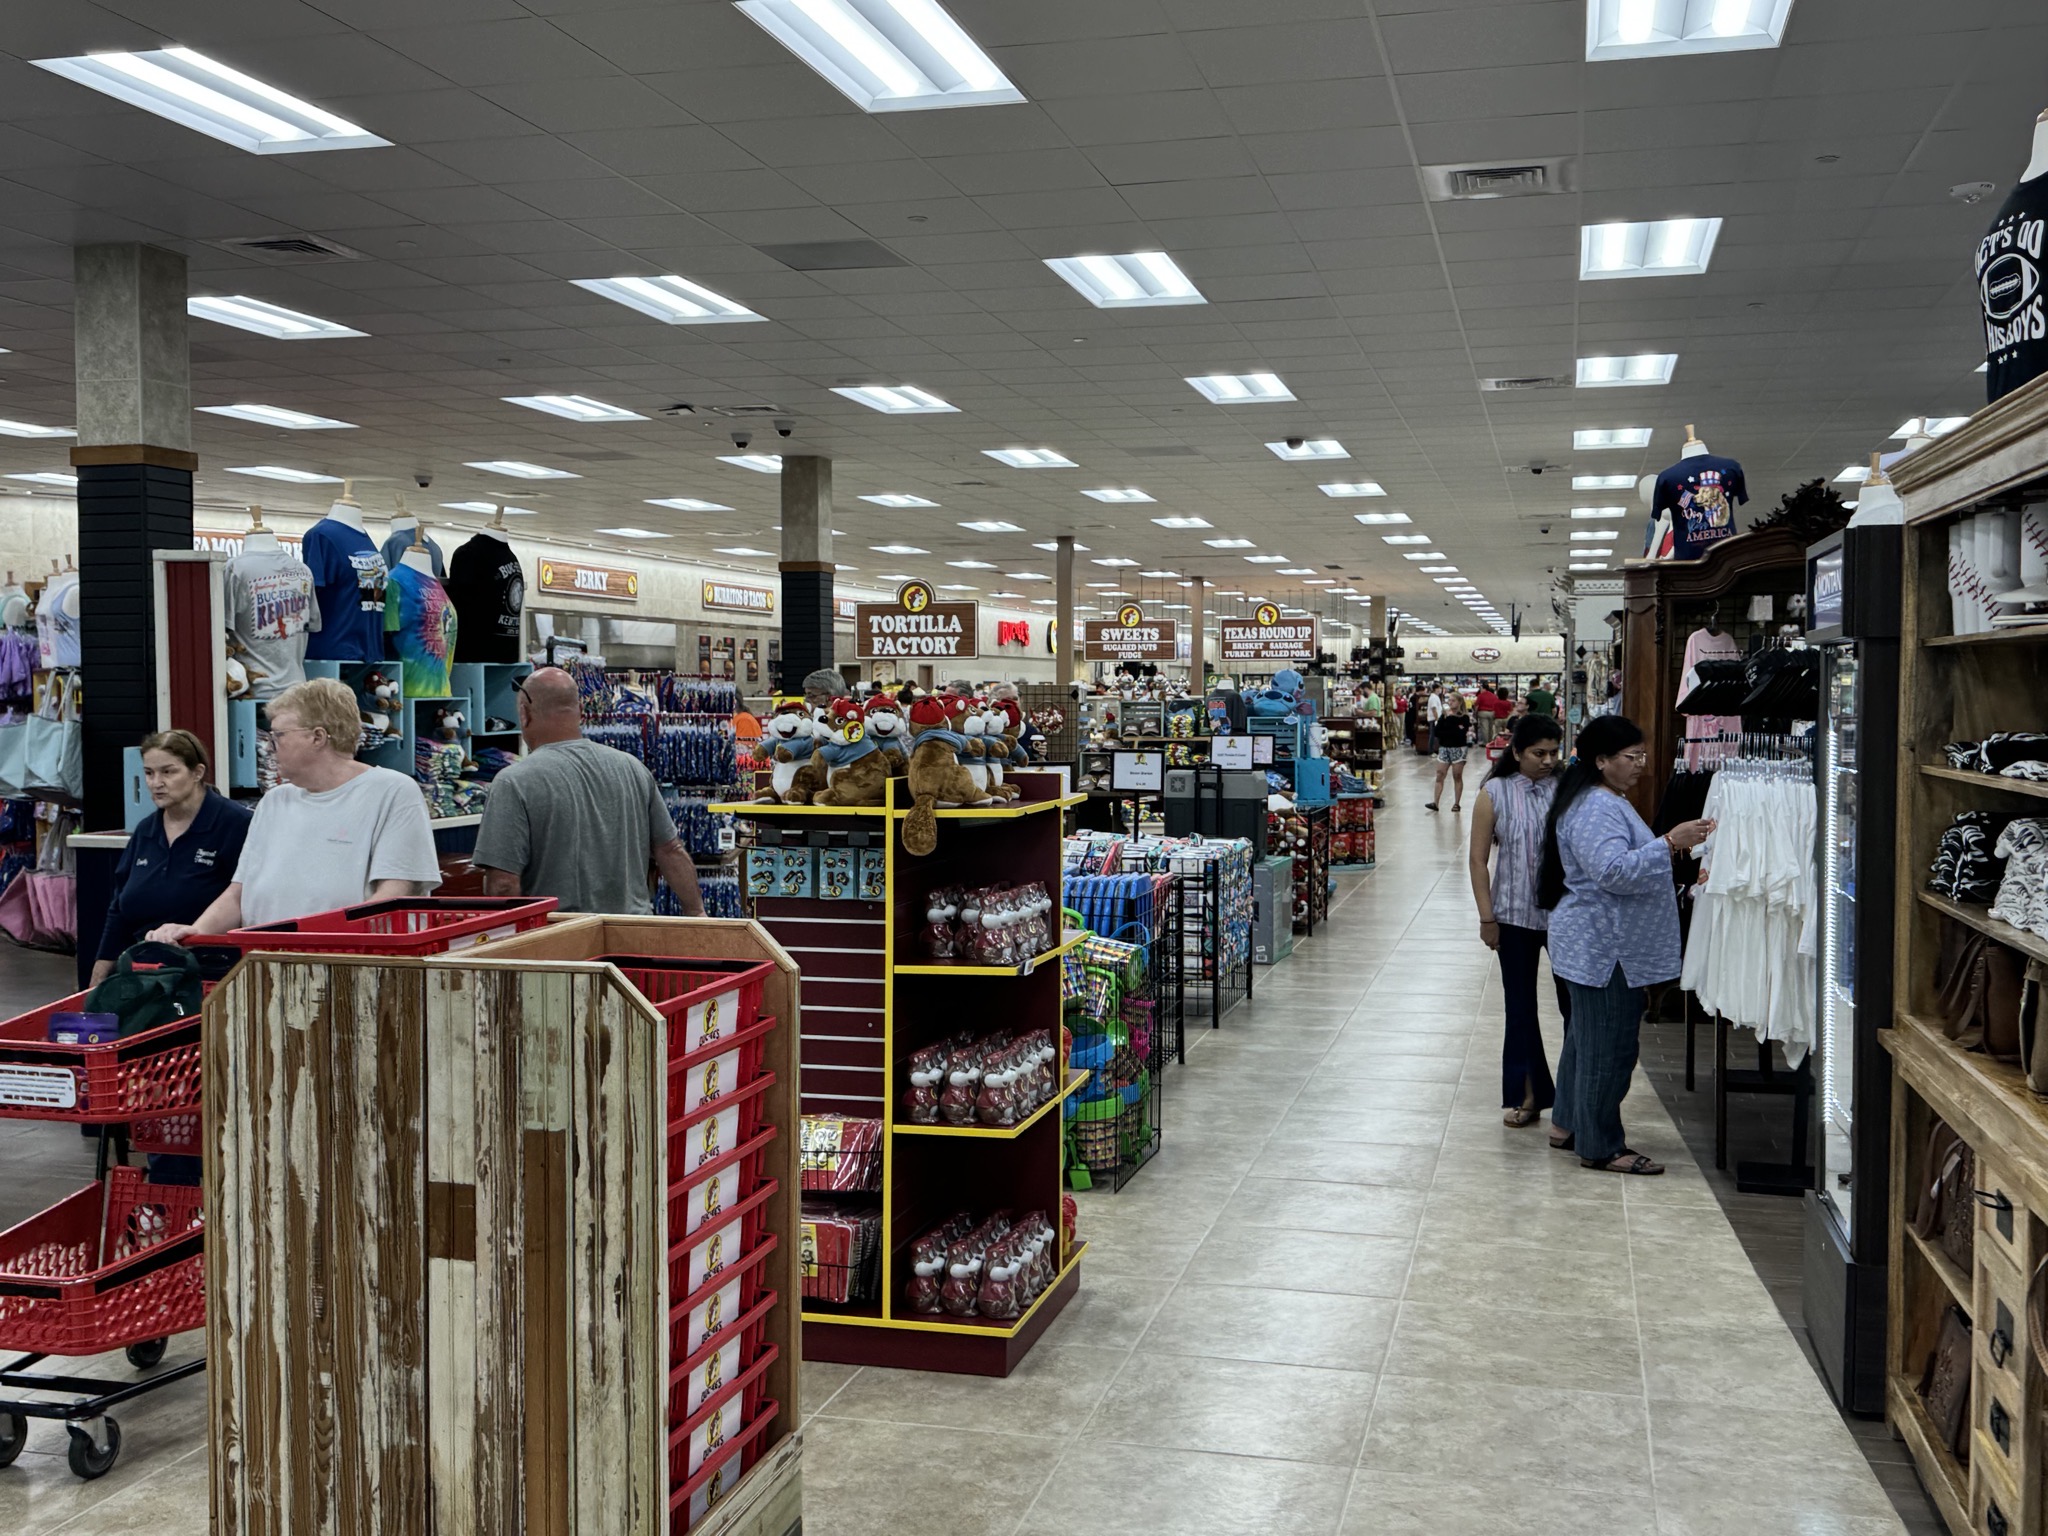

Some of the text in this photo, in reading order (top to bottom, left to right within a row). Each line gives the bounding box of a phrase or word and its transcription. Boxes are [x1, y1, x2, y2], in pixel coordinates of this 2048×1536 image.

[1686, 527, 1733, 542] AMERICA
[574, 569, 608, 591] JERKY
[714, 586, 766, 608] BURRITOS & TACOS
[869, 614, 963, 634] TORTILLA
[1100, 627, 1160, 641] SWEETS
[1224, 626, 1312, 640] TEXAS ROUND UP
[872, 636, 960, 655] FACTORY
[1103, 643, 1157, 651] SUGARED NUTS
[1232, 642, 1303, 650] BRISKET SAUSAGE
[1118, 651, 1142, 659] FUDGE
[1224, 650, 1311, 658] TURKEY PULLED PORK
